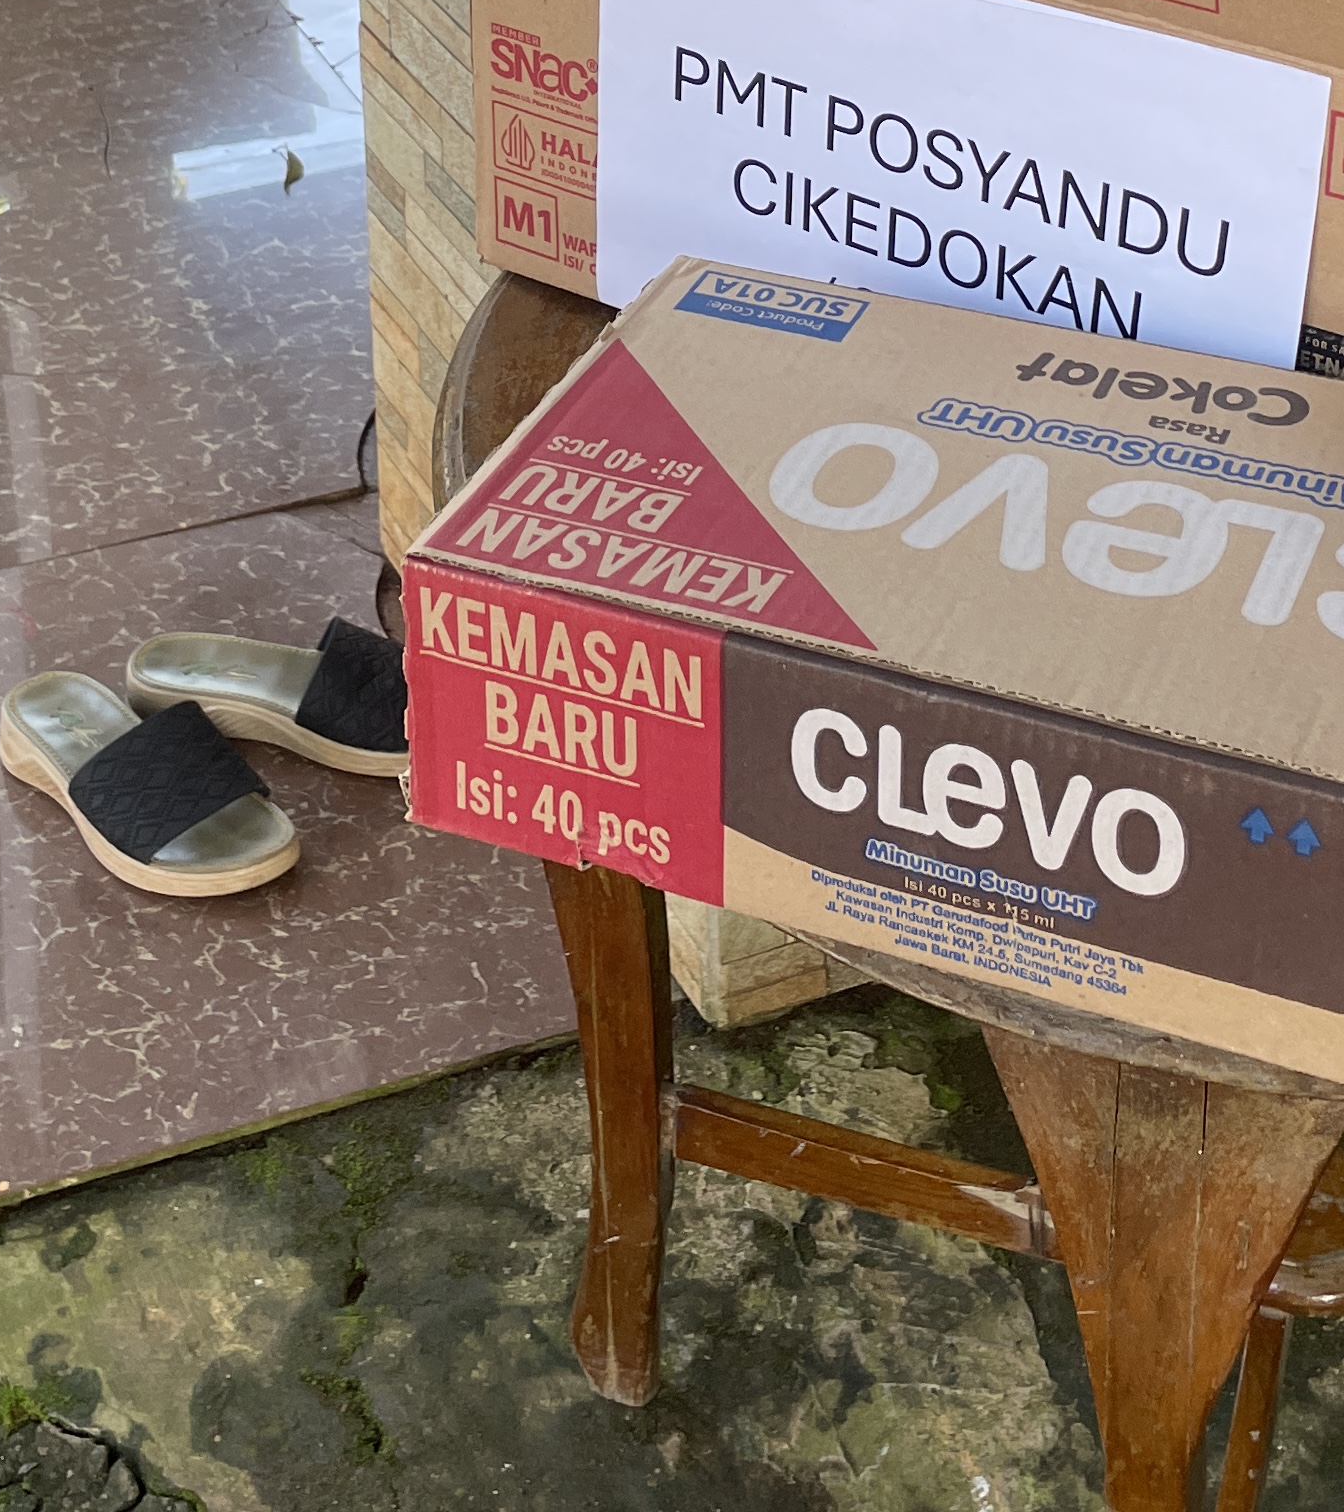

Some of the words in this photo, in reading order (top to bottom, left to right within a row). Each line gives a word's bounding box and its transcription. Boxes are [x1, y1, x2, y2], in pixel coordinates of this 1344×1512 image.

[492, 23, 540, 47] MEMBER
[673, 45, 808, 138] PMT
[825, 93, 1231, 277] POSYANDU
[503, 194, 552, 244] M1
[732, 158, 1142, 340] CIKEDOKAN
[706, 298, 755, 317] Code:
[756, 311, 826, 331] Product
[776, 291, 850, 317] SUC
[1304, 335, 1328, 350] FOR
[1015, 351, 1311, 427] Cokelat
[917, 397, 1034, 442] UHT
[1031, 418, 1156, 465] Susu
[1148, 414, 1232, 445] Rasa
[546, 434, 609, 461] pcs
[604, 446, 648, 472] 40
[497, 463, 687, 533] BARU
[455, 508, 788, 614] KEMASAN
[419, 585, 702, 720] KEMASAN
[485, 679, 638, 777] BARU
[456, 760, 518, 825] Isi:
[531, 784, 584, 841] 40
[597, 810, 671, 864] pcs
[865, 838, 977, 888] Minuman
[978, 869, 1038, 905] Susu
[1039, 887, 1099, 920] UHT
[927, 884, 947, 899] 40
[951, 892, 982, 909] pcs
[986, 900, 996, 912] x
[1034, 914, 1055, 929] ml
[835, 889, 893, 916] Kawasan
[896, 906, 943, 929] Industri
[1063, 955, 1090, 971] Kav
[1092, 963, 1118, 980] C-2
[842, 905, 876, 924] Raya
[952, 934, 974, 952] KM
[1013, 952, 1084, 985] Sumedang
[879, 891, 907, 906] oleh
[911, 898, 930, 912] PT
[931, 904, 1009, 934] Garudafood
[1050, 937, 1081, 956] Putri
[1084, 948, 1116, 967] Jaya
[894, 933, 928, 952] Jawa
[973, 954, 1053, 988] INDONESIA
